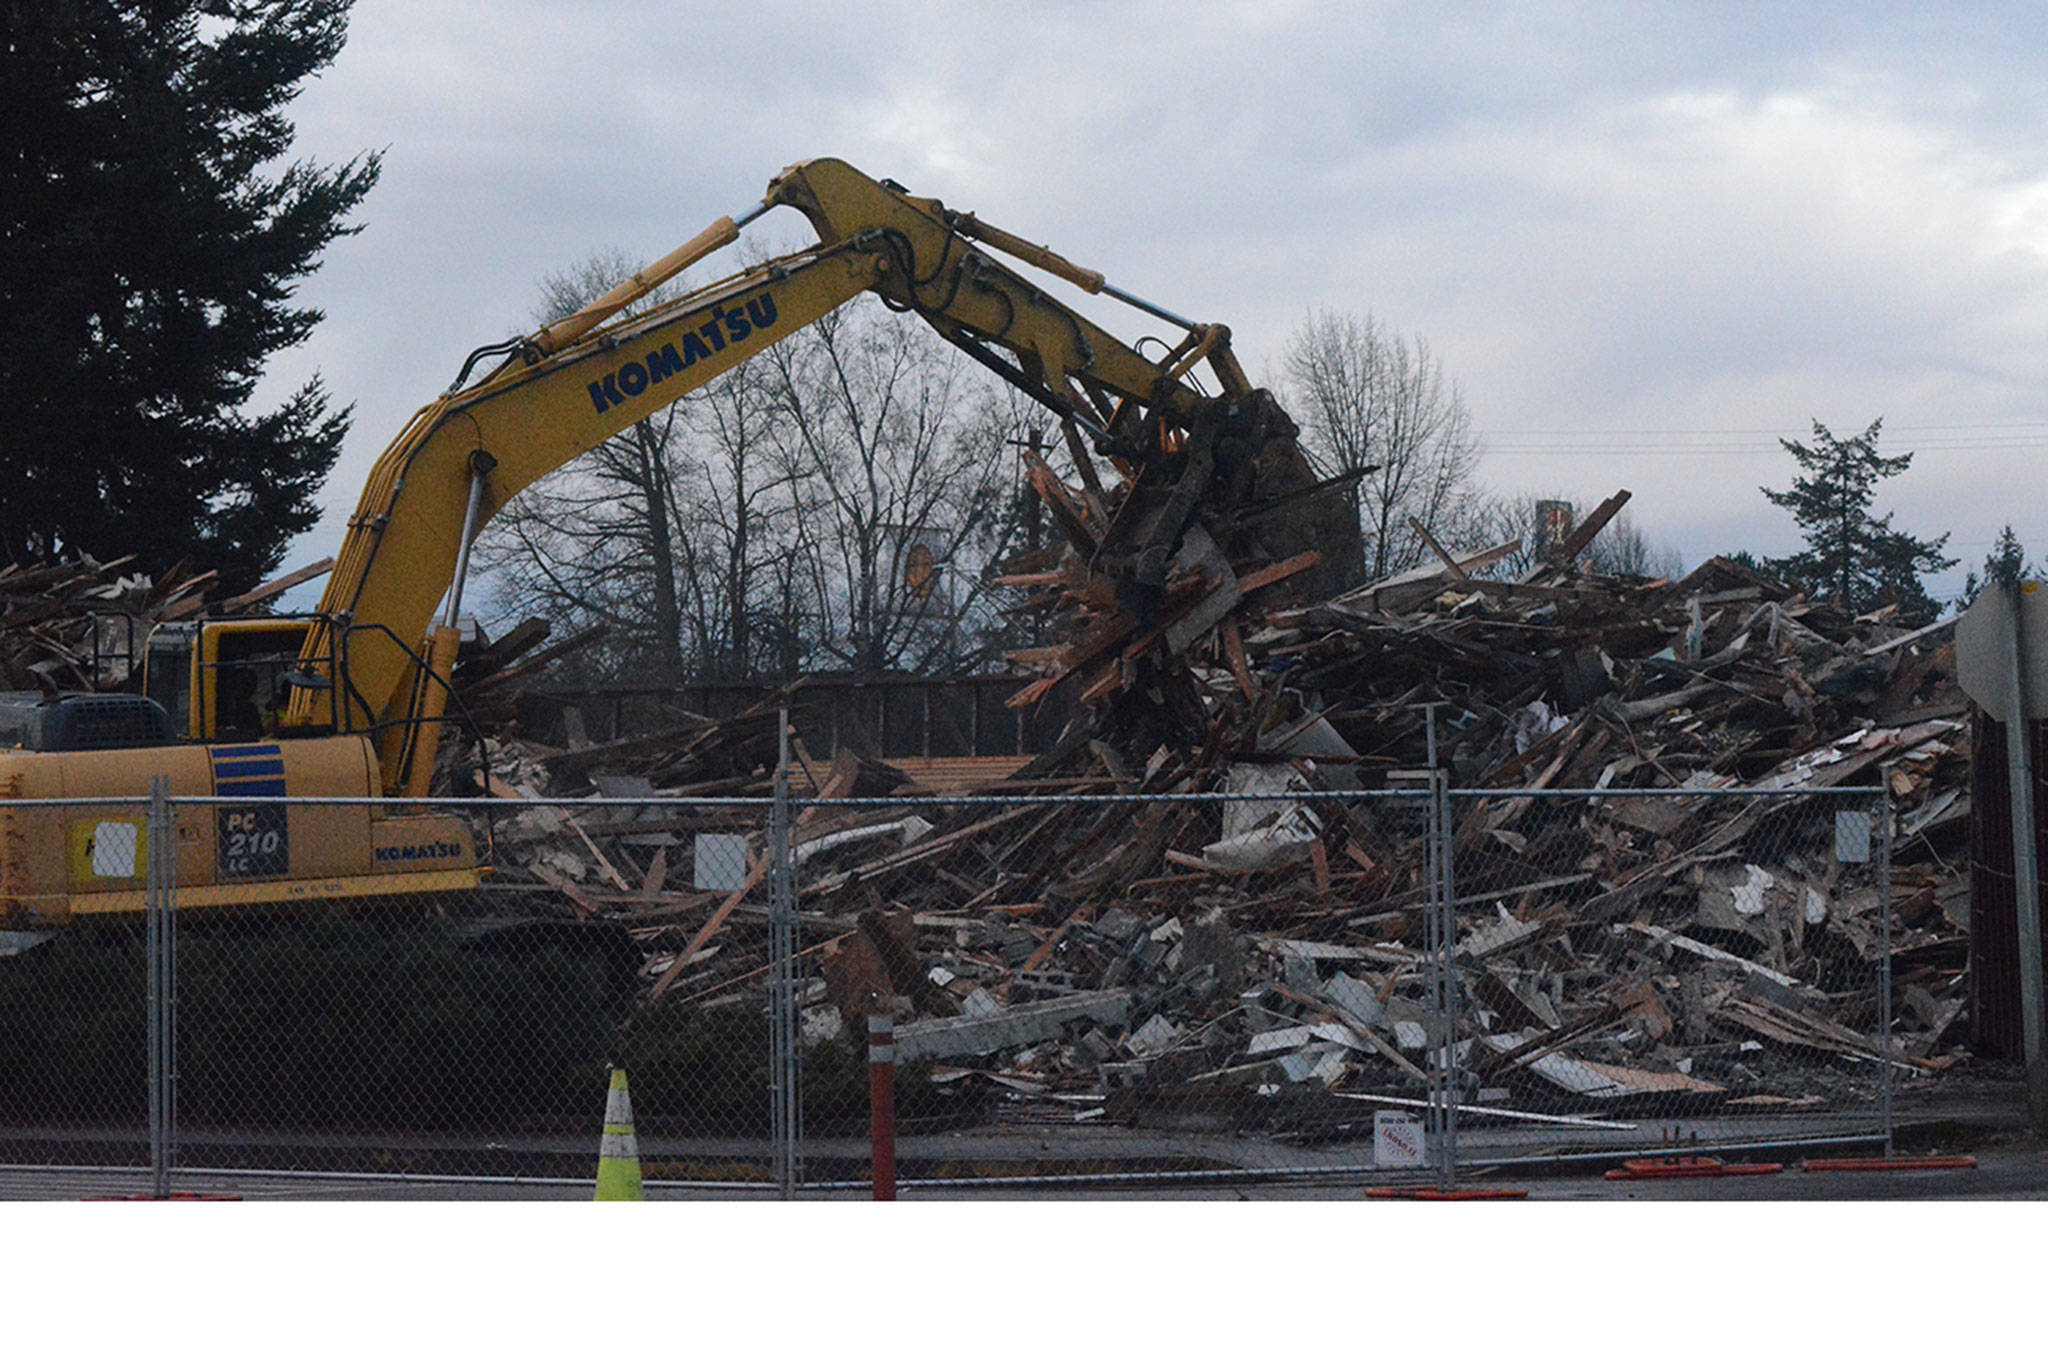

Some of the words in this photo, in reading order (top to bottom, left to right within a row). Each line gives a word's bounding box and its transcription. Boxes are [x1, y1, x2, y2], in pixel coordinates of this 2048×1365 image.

[587, 292, 778, 414] KOMATSU
[228, 812, 256, 831] PC
[227, 831, 279, 855] 210
[376, 841, 461, 860] KOMATSU
[229, 858, 249, 871] LC
